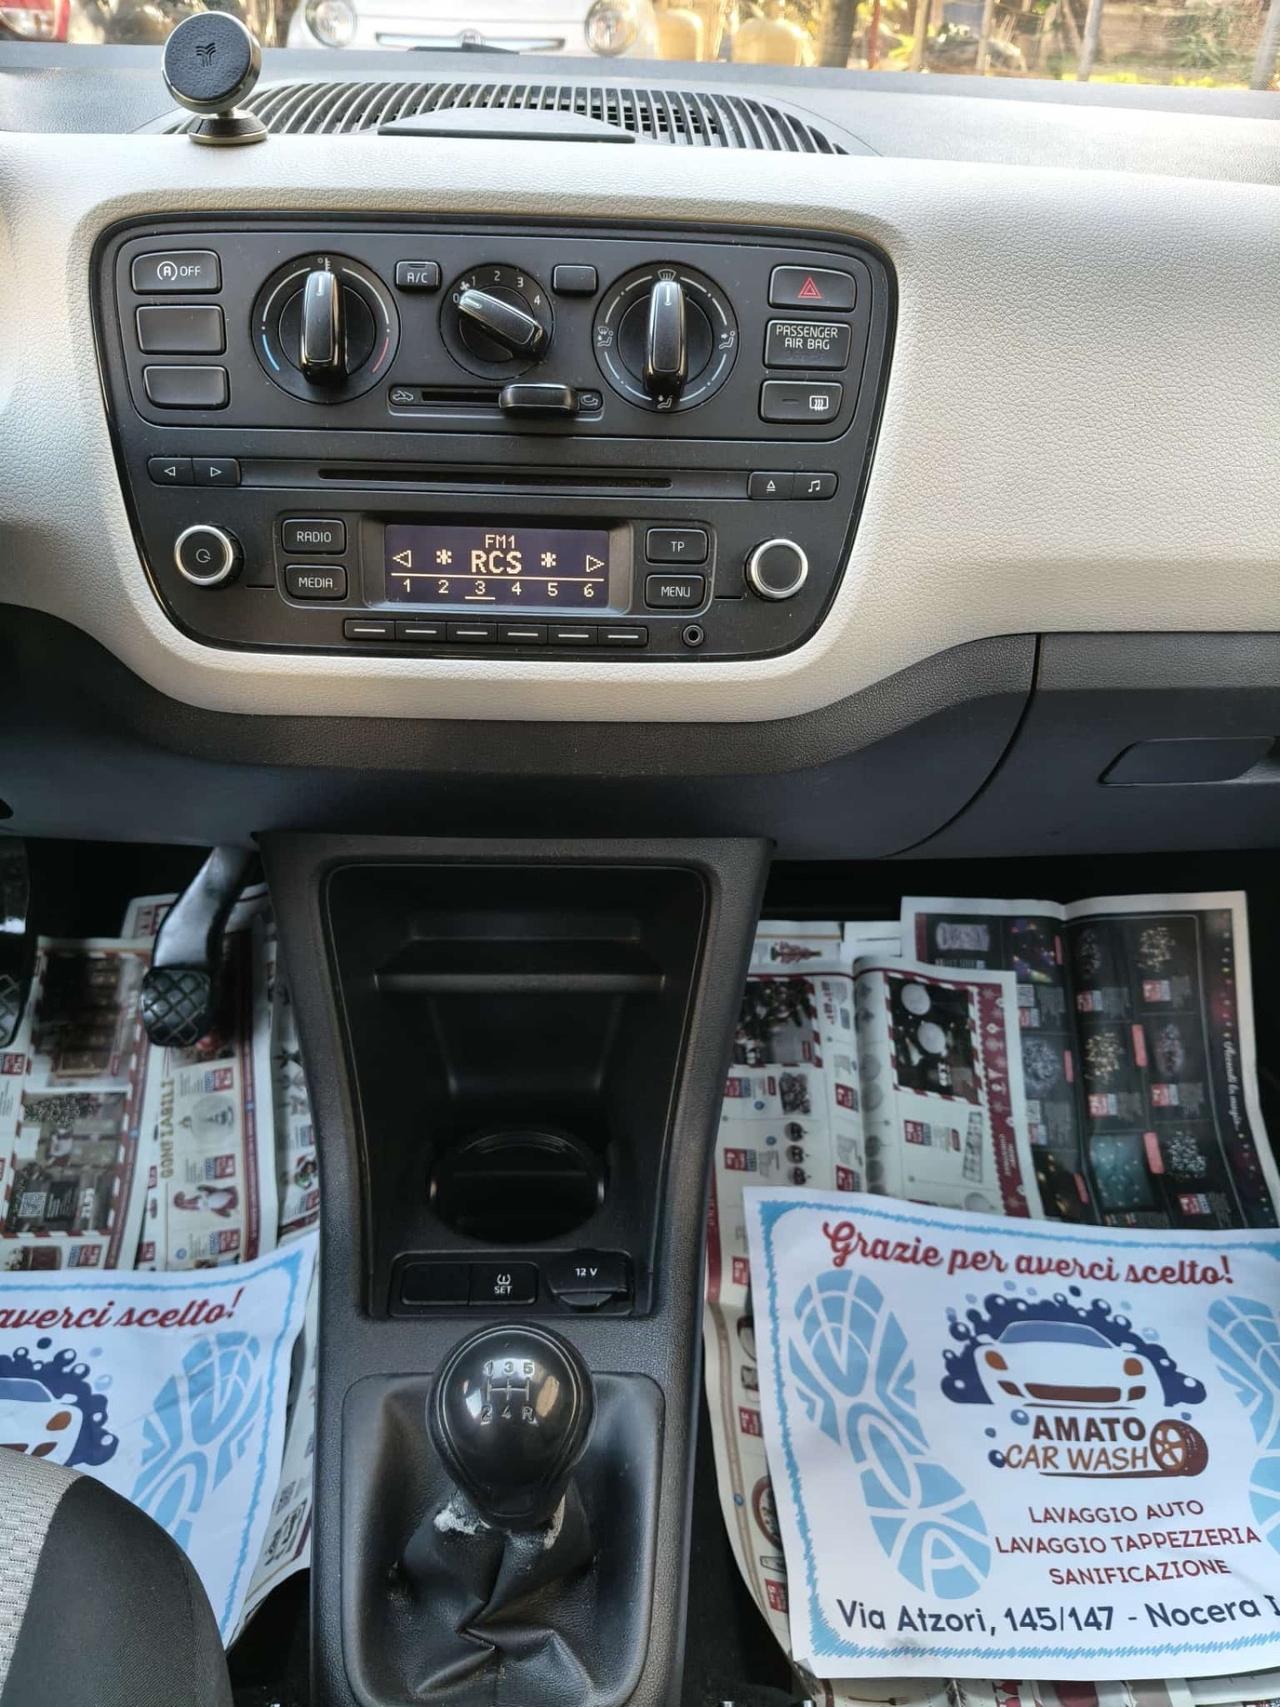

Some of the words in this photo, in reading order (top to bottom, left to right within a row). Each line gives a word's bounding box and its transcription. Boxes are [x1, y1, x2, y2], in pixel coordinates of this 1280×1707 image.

[179, 265, 201, 278] OFF
[406, 272, 428, 284] A/C
[494, 270, 501, 281] 2
[471, 276, 477, 286] 1
[517, 276, 524, 288] 3
[452, 293, 460, 303] 0
[533, 295, 541, 305] 4
[776, 324, 838, 338] PASSENGER
[784, 337, 804, 349] AIR
[807, 339, 830, 350] BAG
[296, 530, 332, 543] RADIO
[484, 534, 517, 549] FM1
[671, 541, 685, 552] TP
[470, 550, 523, 575] RCS
[298, 576, 333, 589] MEDIA
[403, 579, 412, 593] 1
[438, 580, 449, 594] 2
[474, 581, 486, 595] 3
[511, 582, 522, 596] 4
[547, 583, 559, 597] 5
[583, 584, 595, 598] 6
[660, 586, 691, 598] MENU
[823, 1220, 943, 1268] Grazie
[948, 1248, 1007, 1284] per
[1015, 1256, 1120, 1283] averci
[1124, 1255, 1234, 1284] scelto!
[575, 1267, 588, 1276] 12
[589, 1267, 598, 1277] V
[494, 1285, 512, 1295] SET
[0, 1301, 115, 1329] averci
[113, 1287, 244, 1328] scelto!
[484, 1360, 494, 1376] 1
[503, 1361, 515, 1373] 3
[523, 1361, 534, 1374] 5
[480, 1404, 493, 1423] 2
[501, 1406, 512, 1418] 4
[522, 1406, 535, 1421] R
[1031, 1415, 1147, 1442] AMATO
[1005, 1445, 1061, 1470] CAR
[1067, 1443, 1149, 1472] WASH
[1028, 1505, 1139, 1524] LAVAGGIO
[1147, 1500, 1205, 1519] AUTO
[995, 1535, 1107, 1554] LAVAGGIO
[1111, 1527, 1262, 1553] TAPPEZZERIA
[1048, 1559, 1232, 1586] SANIFICAZIONE
[836, 1599, 886, 1631] Via
[897, 1602, 996, 1637] Atzori,
[1004, 1606, 1114, 1632] 145/147
[1144, 1600, 1261, 1628] Nocera
